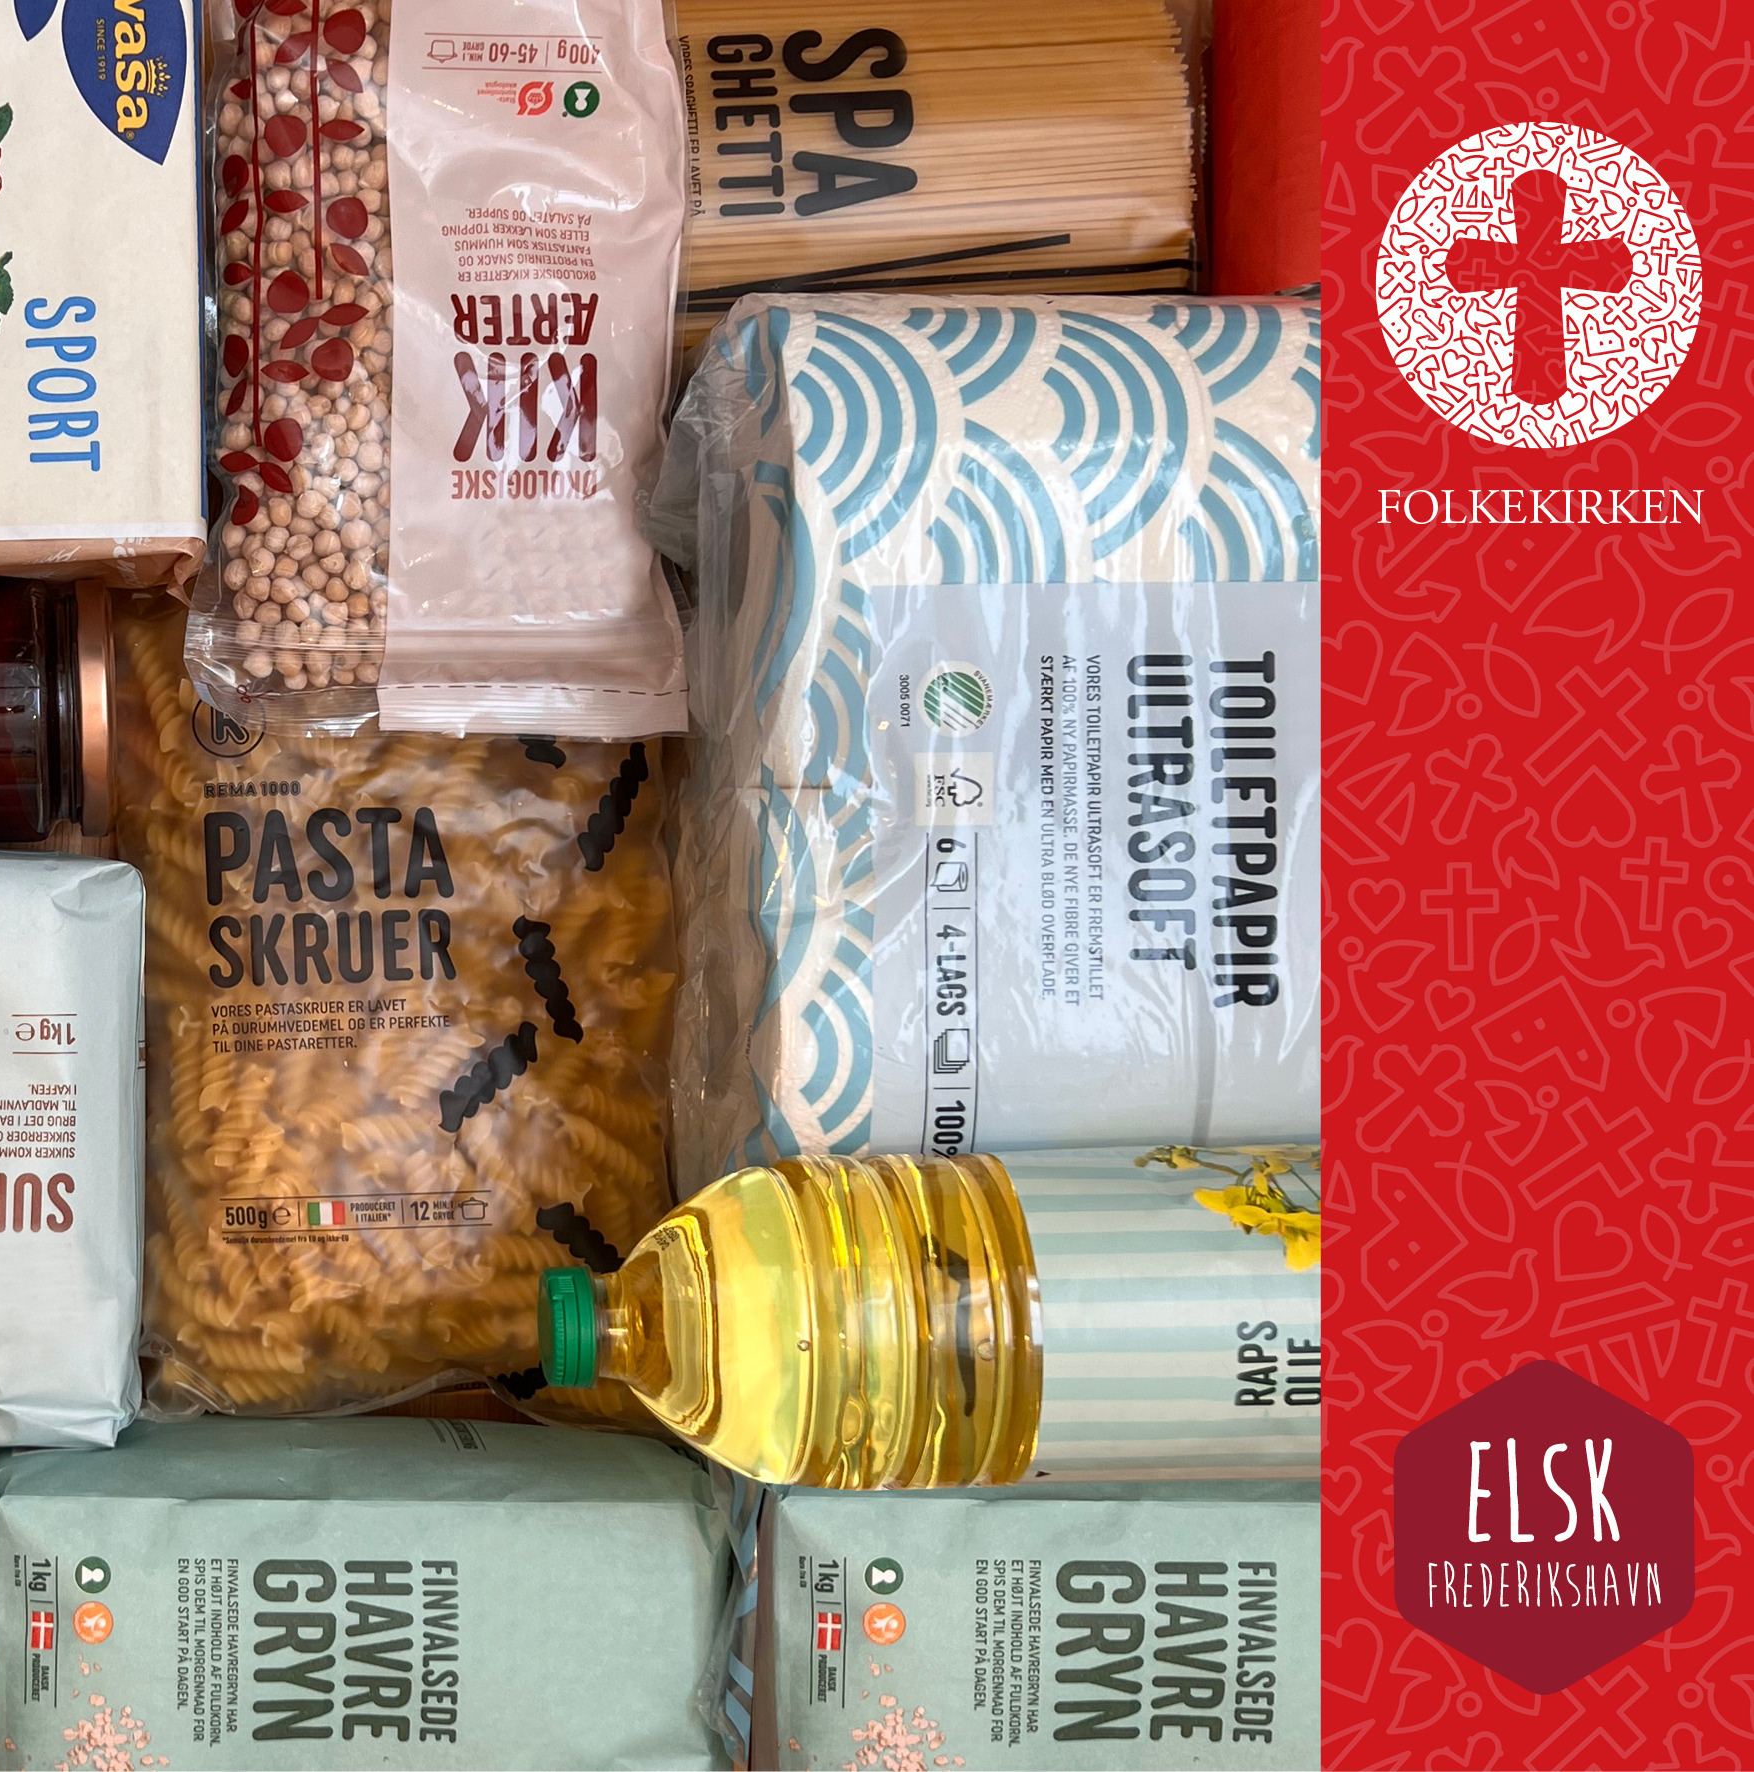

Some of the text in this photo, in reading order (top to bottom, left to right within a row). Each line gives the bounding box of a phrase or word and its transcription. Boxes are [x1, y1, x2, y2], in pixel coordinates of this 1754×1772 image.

[96, 19, 107, 80] SINCE 1919
[463, 42, 484, 51] GRYDE
[467, 53, 483, 61] MIN.
[489, 38, 600, 64] 400g 45-60
[707, 34, 784, 215] GHETTI
[779, 28, 917, 216] SPA
[451, 293, 598, 345] ÆRTER
[24, 296, 100, 471] SPORT
[453, 352, 597, 462] KIK
[452, 470, 597, 500] ØKOLOGISKE
[899, 675, 910, 726] 3005 0071
[204, 781, 301, 798] REMA 1000
[935, 776, 945, 806] FSC
[1127, 655, 1196, 970] ULTRASOFT
[1210, 651, 1279, 1006] TOILETPAPIR
[204, 807, 455, 906] PASTA
[936, 838, 964, 852] 6
[208, 908, 456, 989] SKRUER
[936, 925, 967, 1016] 4-LAGS
[211, 999, 406, 1017] VORES PASTASKRUER ER LAVET
[213, 1014, 450, 1035] PÅ DURUMHVEDEMEL OG ER PERFEKTE
[213, 1036, 357, 1053] TIL DINE PASTARETTER.
[29, 1084, 71, 1095] KAFFEN.
[62, 1100, 76, 1111] TIL
[7, 1131, 75, 1142] SUKKERROER
[24, 1116, 43, 1126] DET
[48, 1116, 75, 1126] BRUG
[35, 1147, 75, 1158] SUKKER
[226, 1207, 267, 1229] 500g
[351, 1201, 395, 1212] PRODUCERET
[410, 1201, 429, 1220] 12
[1235, 1321, 1278, 1406] RAPS
[252, 1559, 336, 1741] GRYN
[342, 1561, 413, 1742] HAVRE
[419, 1561, 458, 1743] FINVALSEDE
[1053, 1561, 1146, 1741] GRYN
[1150, 1562, 1228, 1742] HAVRE
[1232, 1562, 1277, 1744] FINVALSEDE
